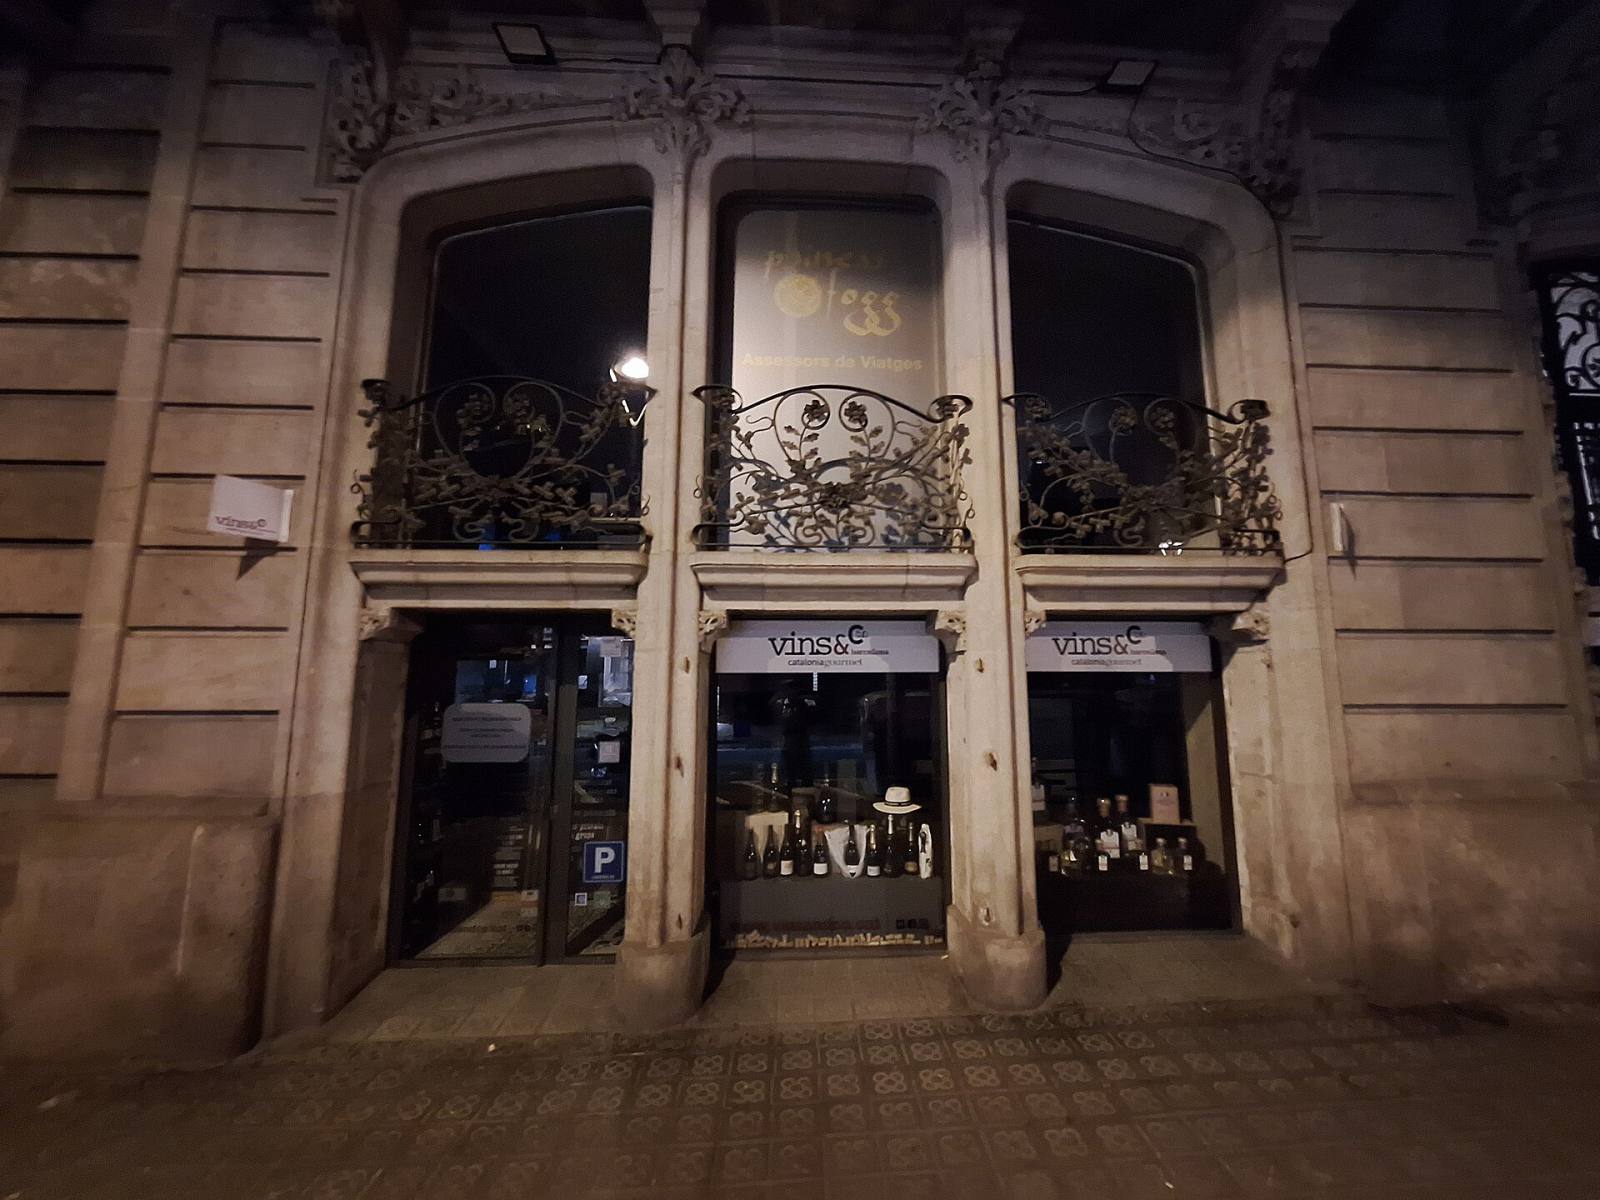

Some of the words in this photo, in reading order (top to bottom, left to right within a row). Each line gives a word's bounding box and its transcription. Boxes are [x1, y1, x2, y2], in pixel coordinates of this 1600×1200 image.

[742, 352, 830, 368] Assessors
[834, 354, 856, 369] de
[860, 354, 922, 372] Viatges
[594, 846, 616, 874] P
